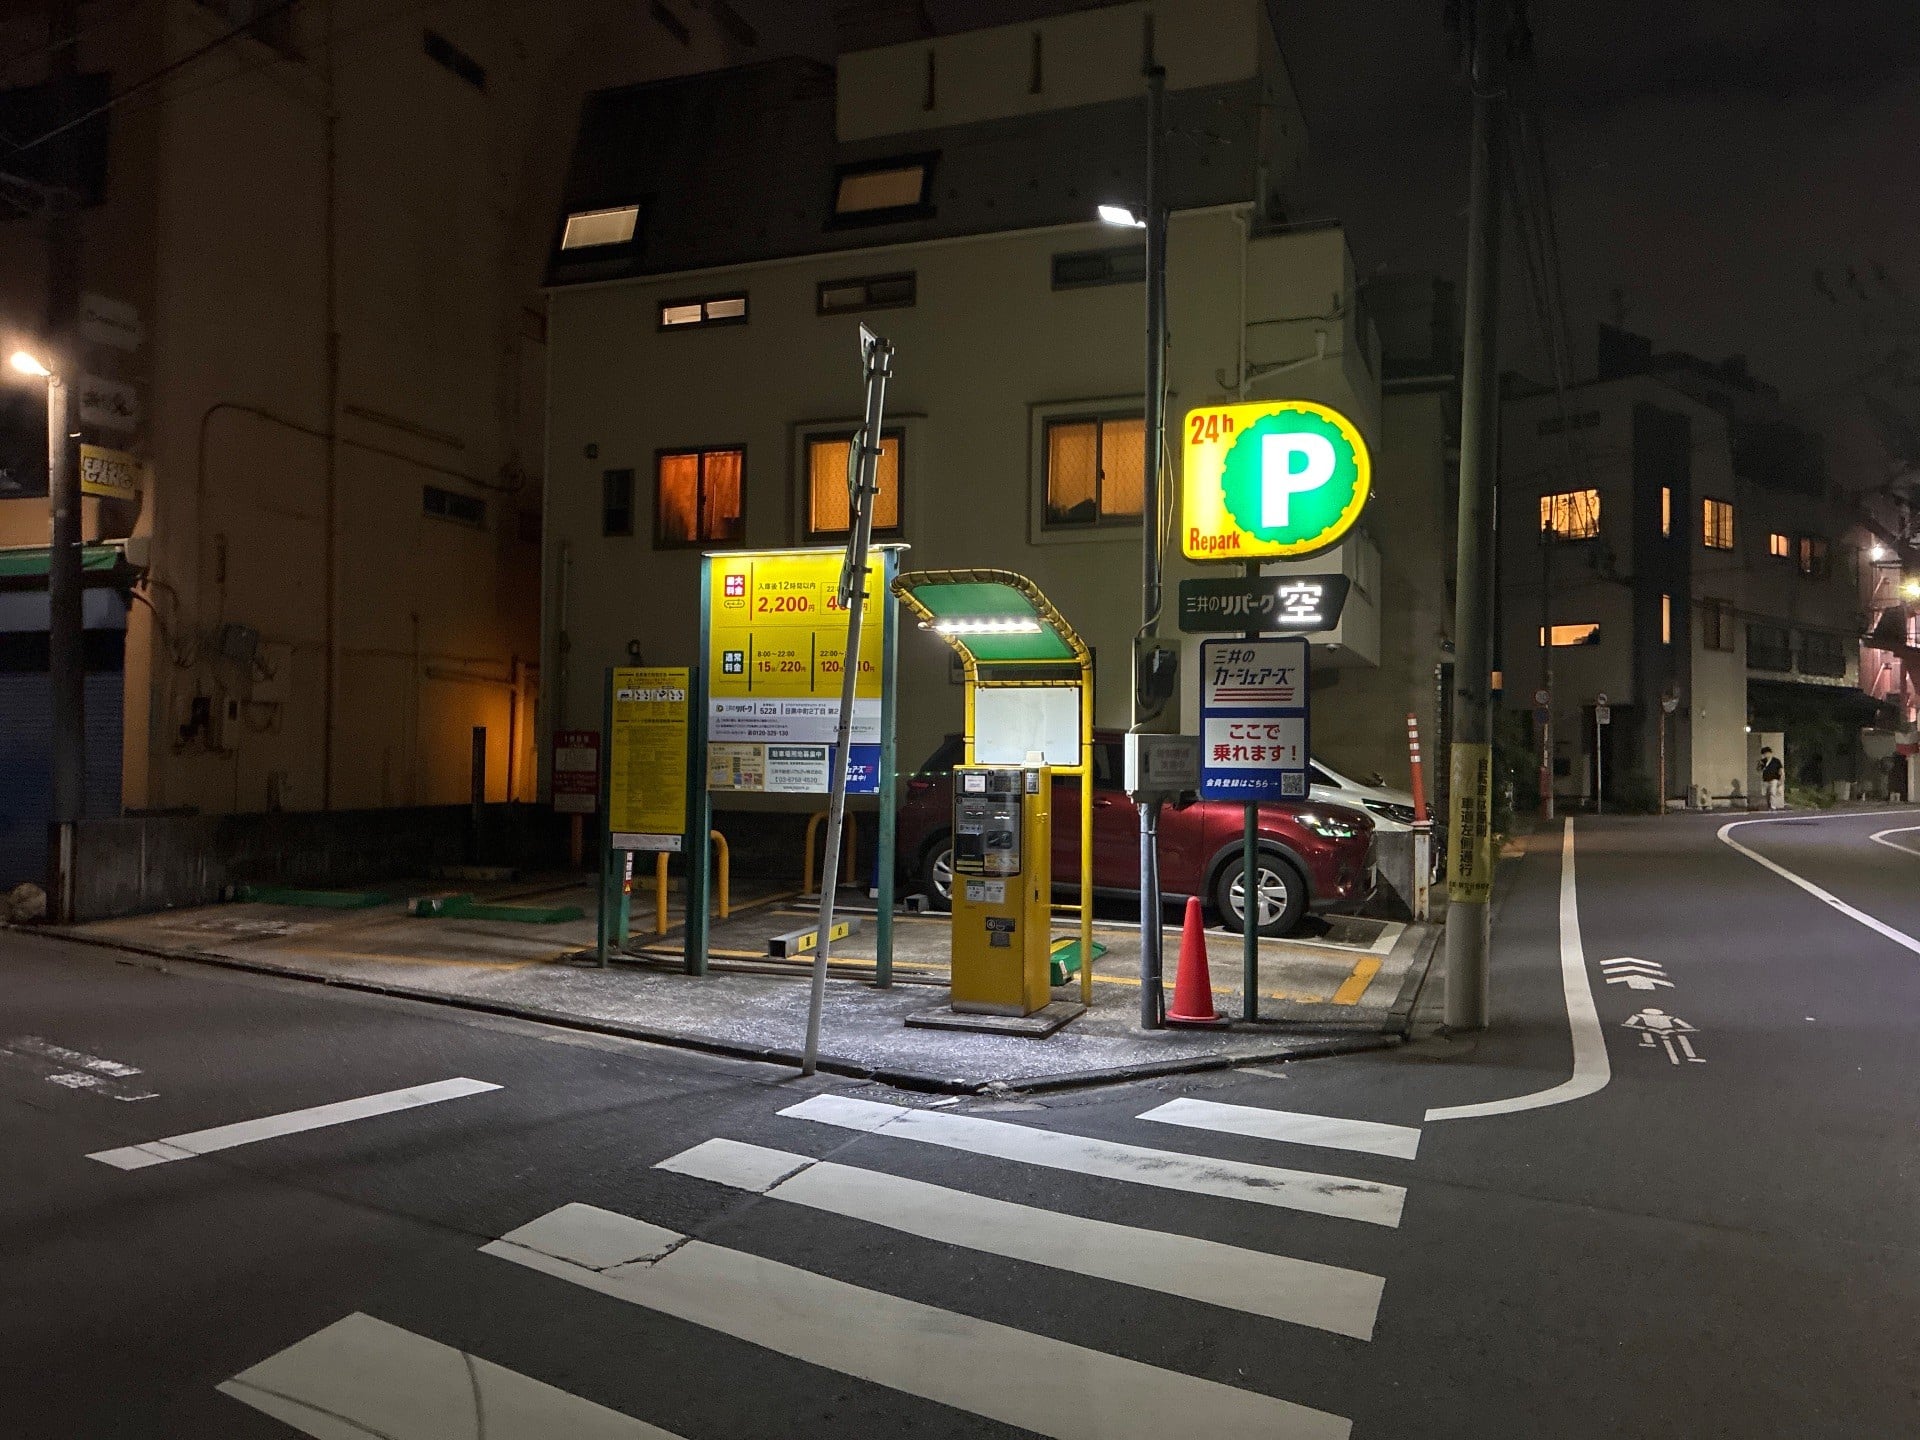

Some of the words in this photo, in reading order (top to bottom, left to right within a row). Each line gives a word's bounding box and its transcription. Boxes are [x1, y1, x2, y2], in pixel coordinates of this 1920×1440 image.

[1191, 413, 1234, 445] 24h
[1261, 432, 1337, 529] P
[1189, 527, 1241, 554] Repark
[758, 596, 815, 613] 2,200円
[1186, 593, 1275, 615] 三井のリパーク
[1278, 582, 1323, 624] 空
[1213, 649, 1255, 665] 三井の
[1212, 667, 1296, 686] カーシェアーズ
[760, 707, 777, 715] 5228
[1229, 723, 1281, 741] ここで
[1205, 778, 1269, 789] 会員登録はこちら
